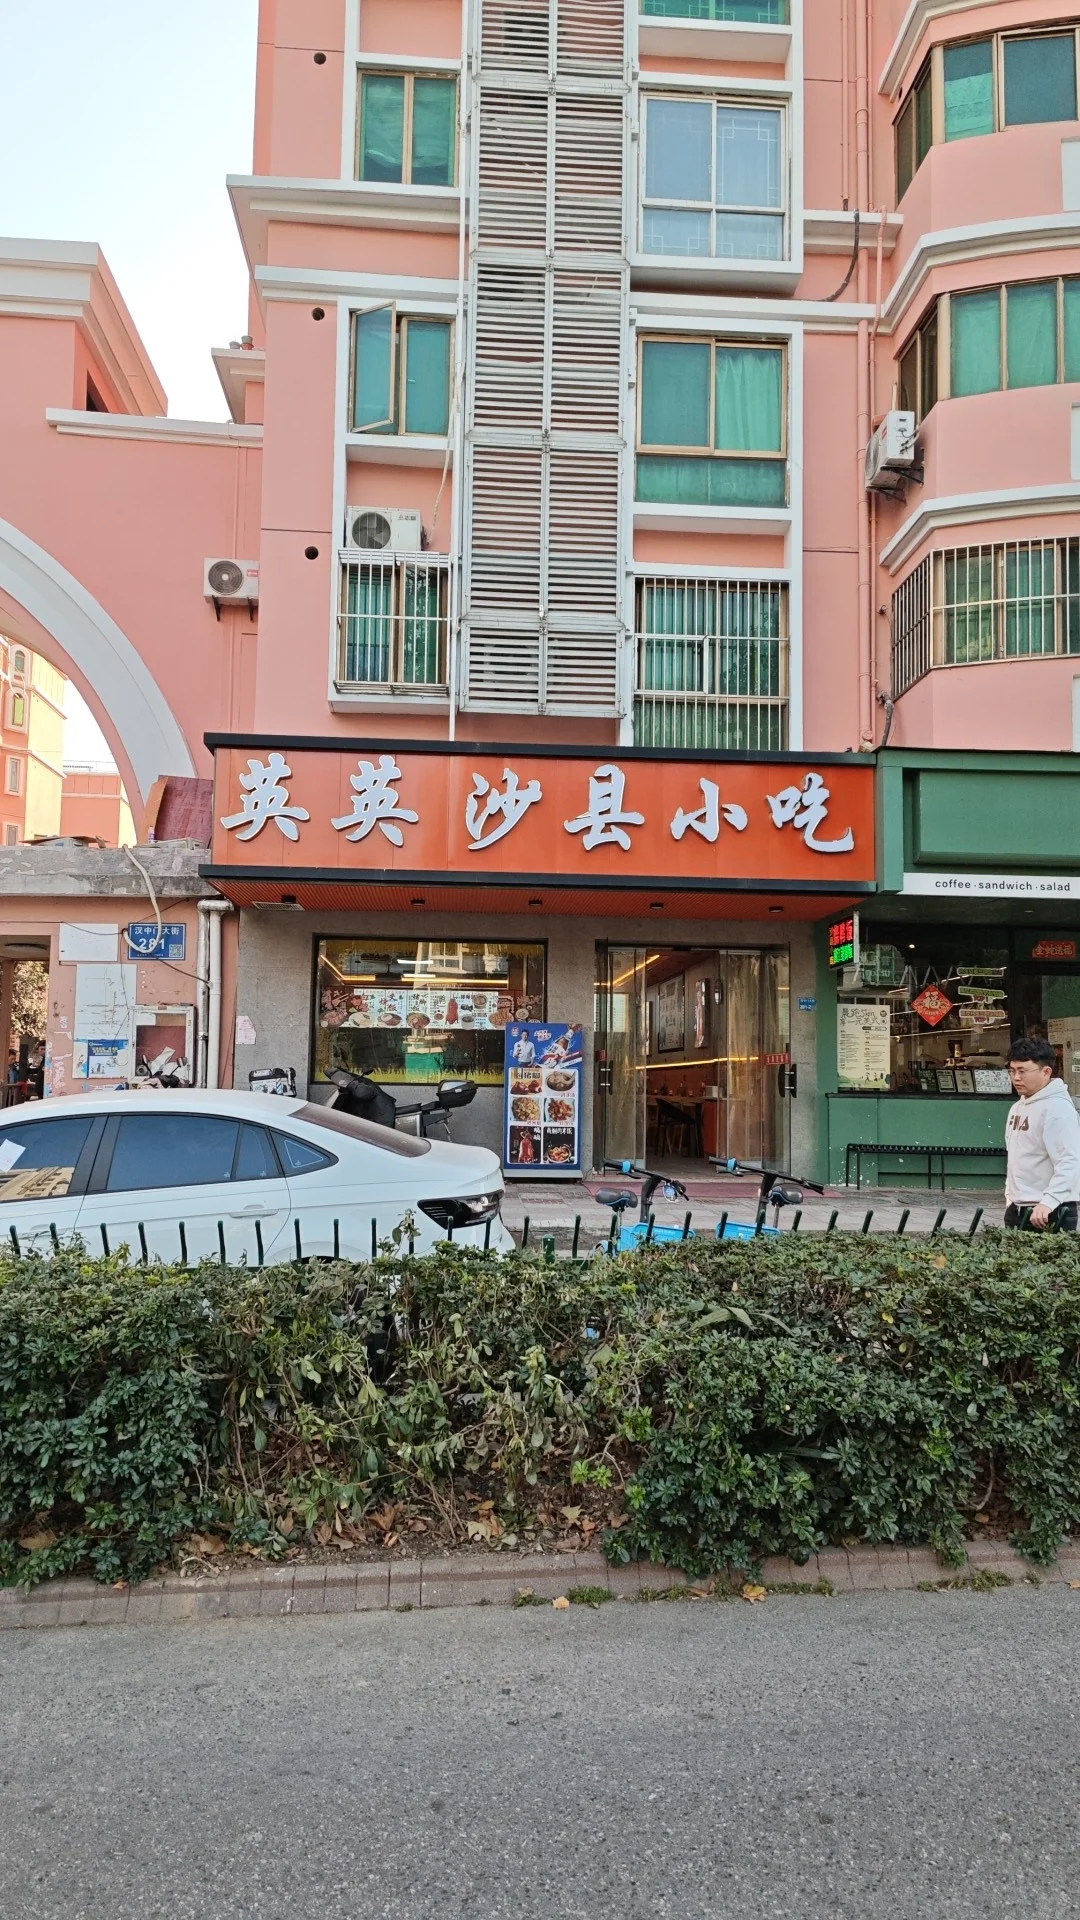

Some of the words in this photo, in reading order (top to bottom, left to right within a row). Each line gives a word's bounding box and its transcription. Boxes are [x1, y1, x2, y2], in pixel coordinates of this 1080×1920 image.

[220, 752, 855, 853] 英英沙县小吃
[935, 879, 971, 889] coffee
[978, 880, 1032, 891] sandwich
[1040, 882, 1071, 892] salad
[138, 937, 165, 950] 281
